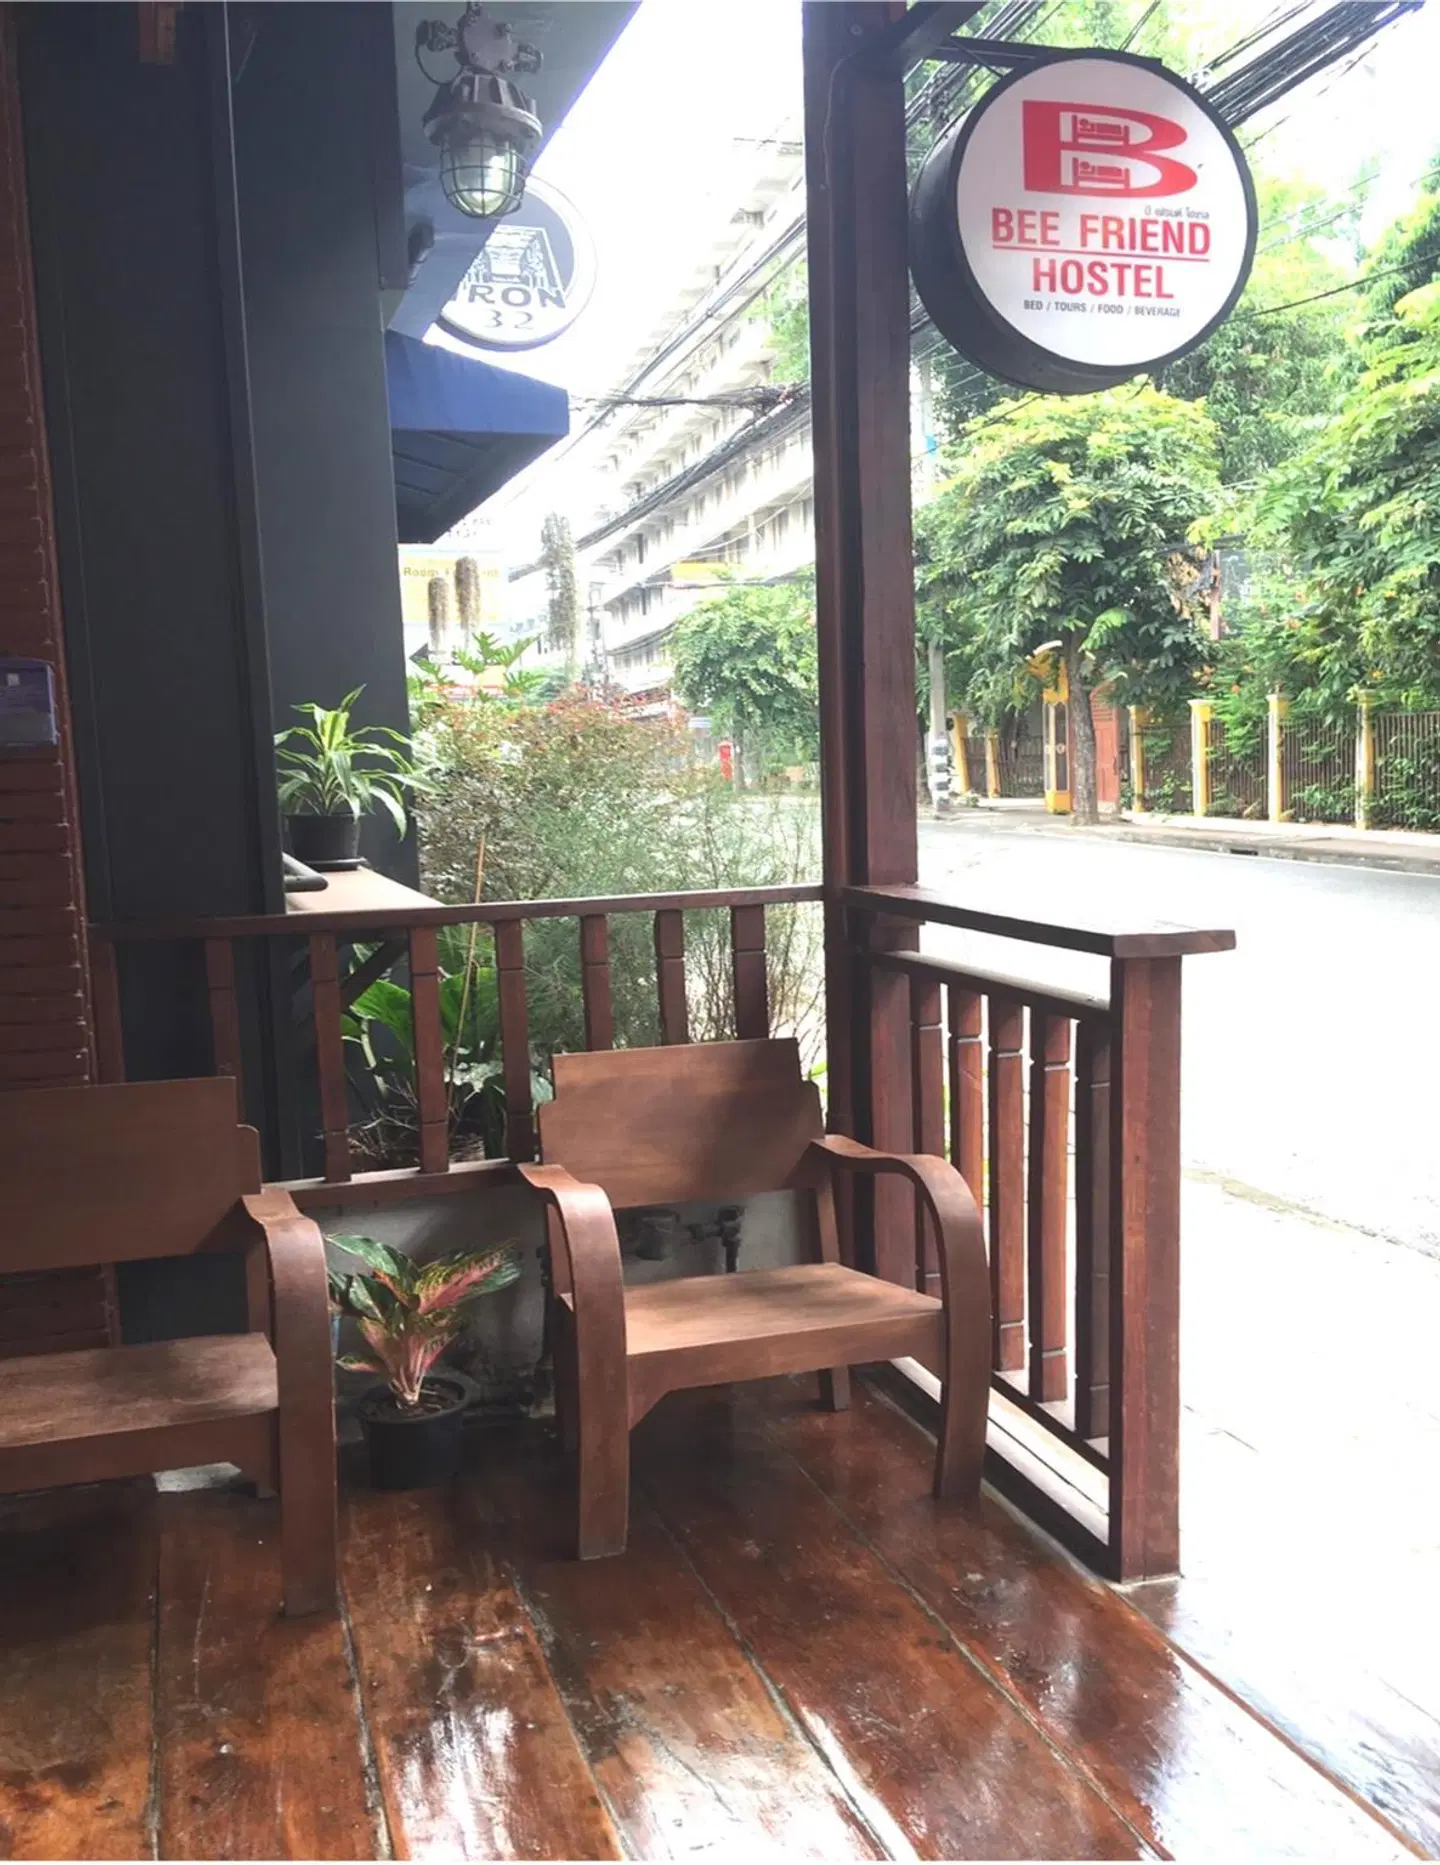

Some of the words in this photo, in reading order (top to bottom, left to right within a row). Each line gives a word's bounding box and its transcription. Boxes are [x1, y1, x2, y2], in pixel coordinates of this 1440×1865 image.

[991, 207, 1060, 246] BEE
[1080, 214, 1211, 255] FRIEND
[1032, 257, 1174, 299] HOSTEL
[485, 309, 533, 330] 32
[1023, 300, 1043, 311] BED
[1055, 301, 1087, 313] TOURS
[1098, 304, 1124, 315] FOOD
